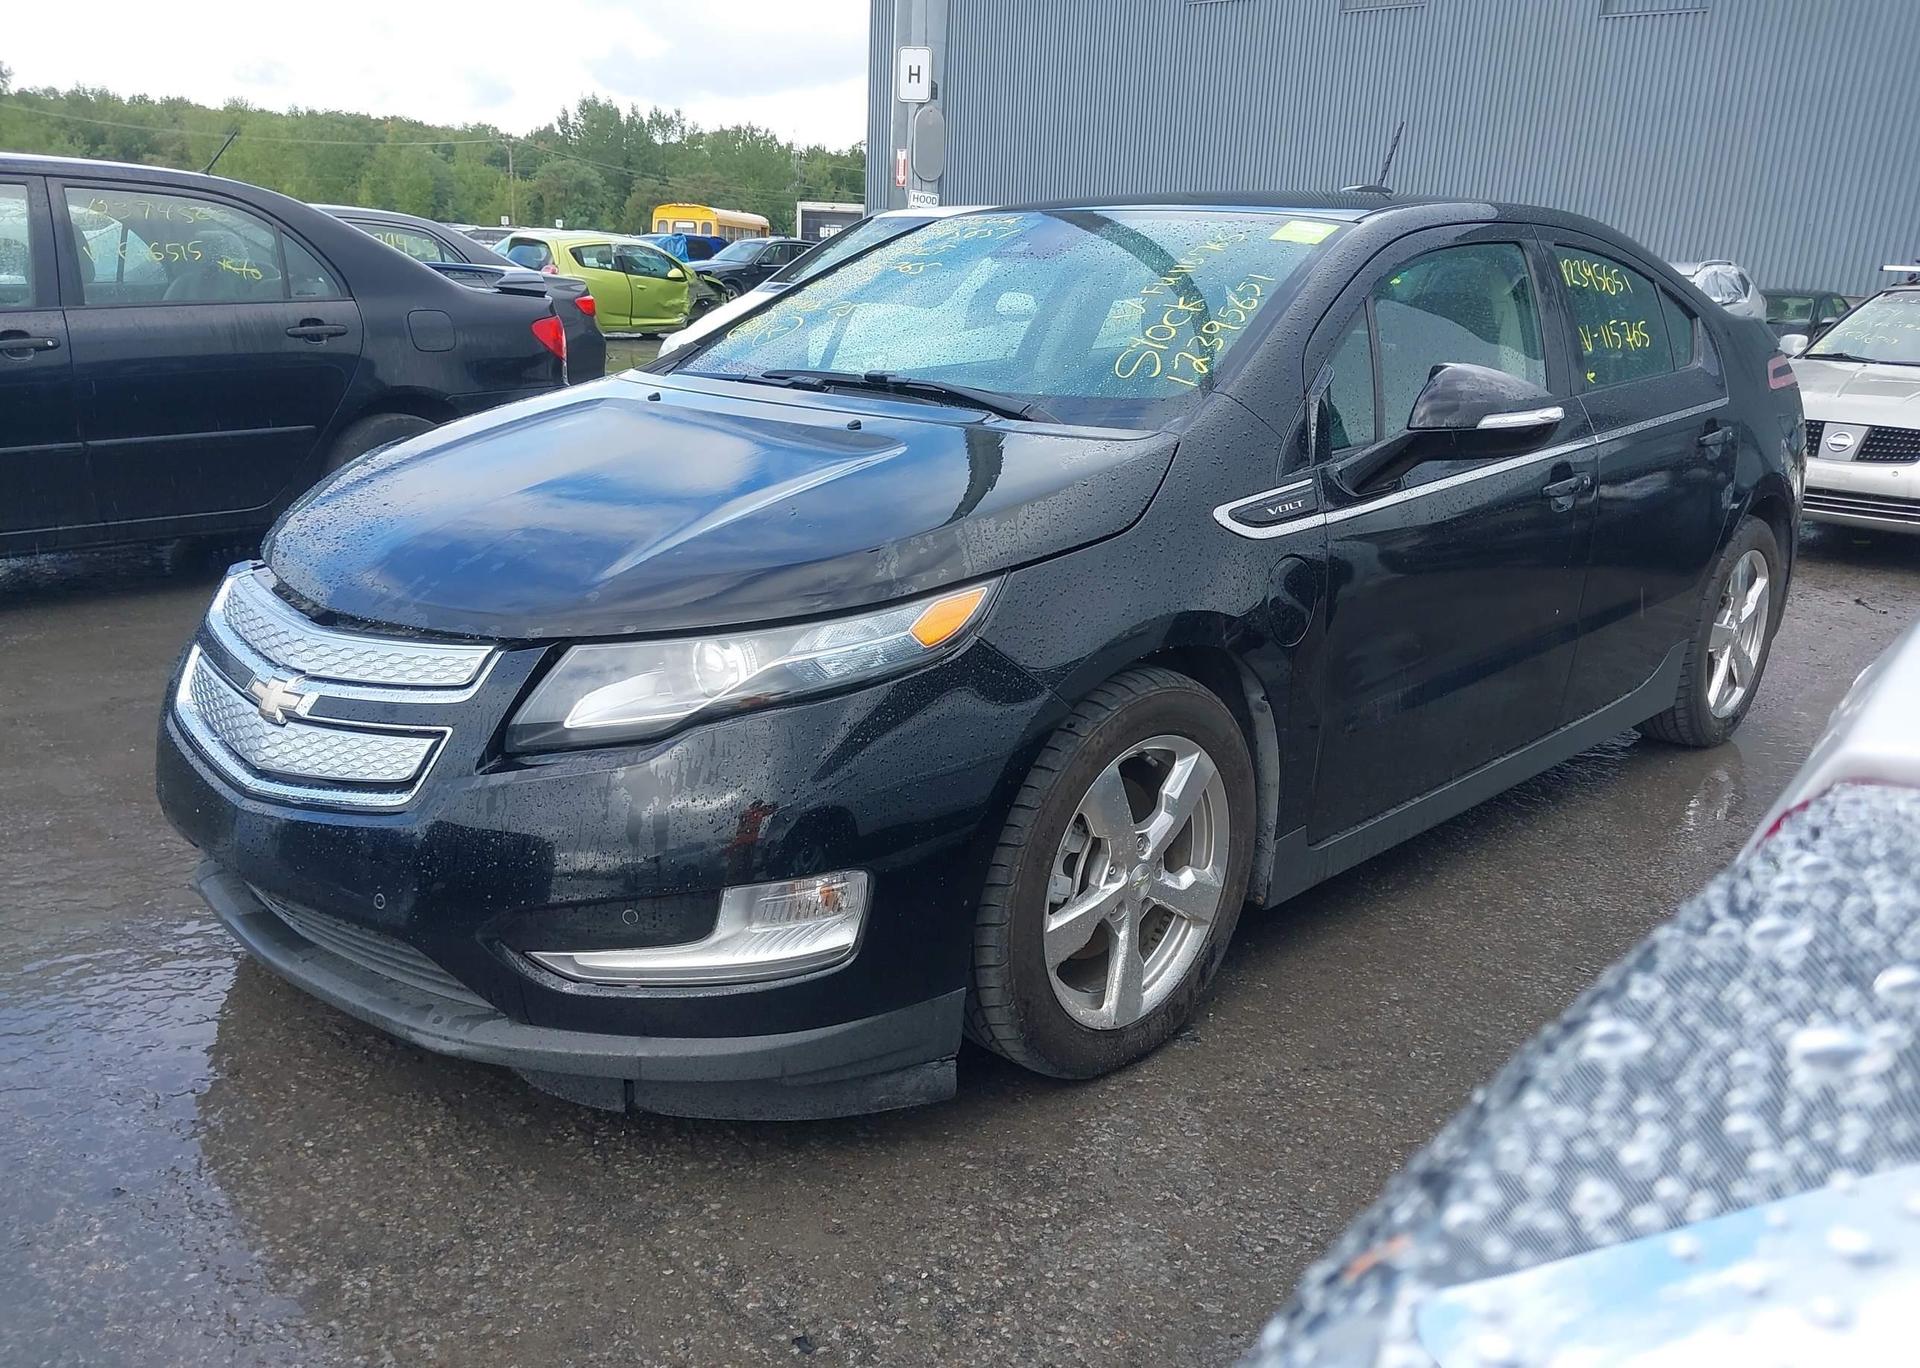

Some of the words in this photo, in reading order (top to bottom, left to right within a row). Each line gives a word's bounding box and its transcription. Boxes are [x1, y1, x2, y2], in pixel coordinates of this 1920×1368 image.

[908, 65, 921, 84] H
[912, 193, 937, 205] HOOD
[1560, 259, 1633, 295] 12395651
[1167, 273, 1276, 387] 12395651
[1267, 500, 1304, 515] VOLT
